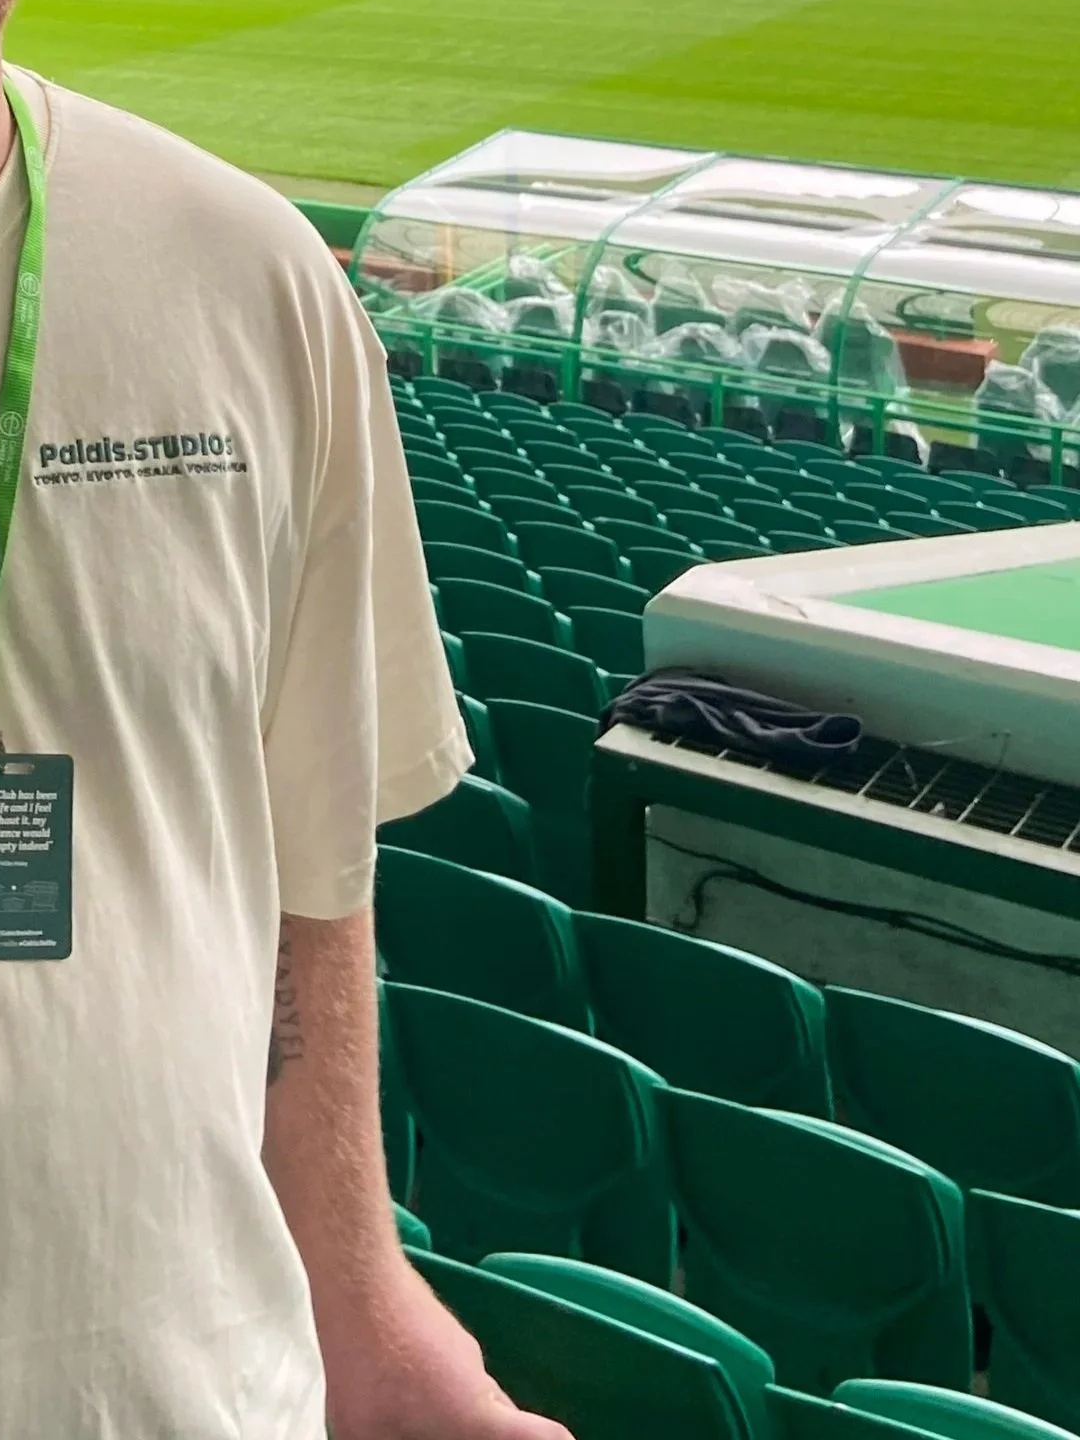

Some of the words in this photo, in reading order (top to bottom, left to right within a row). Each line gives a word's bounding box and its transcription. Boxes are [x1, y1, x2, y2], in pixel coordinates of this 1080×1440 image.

[17, 789, 35, 801] has
[35, 789, 58, 801] been
[9, 802, 29, 813] and
[34, 802, 52, 815] feel
[32, 817, 47, 828] my
[22, 827, 51, 838] would
